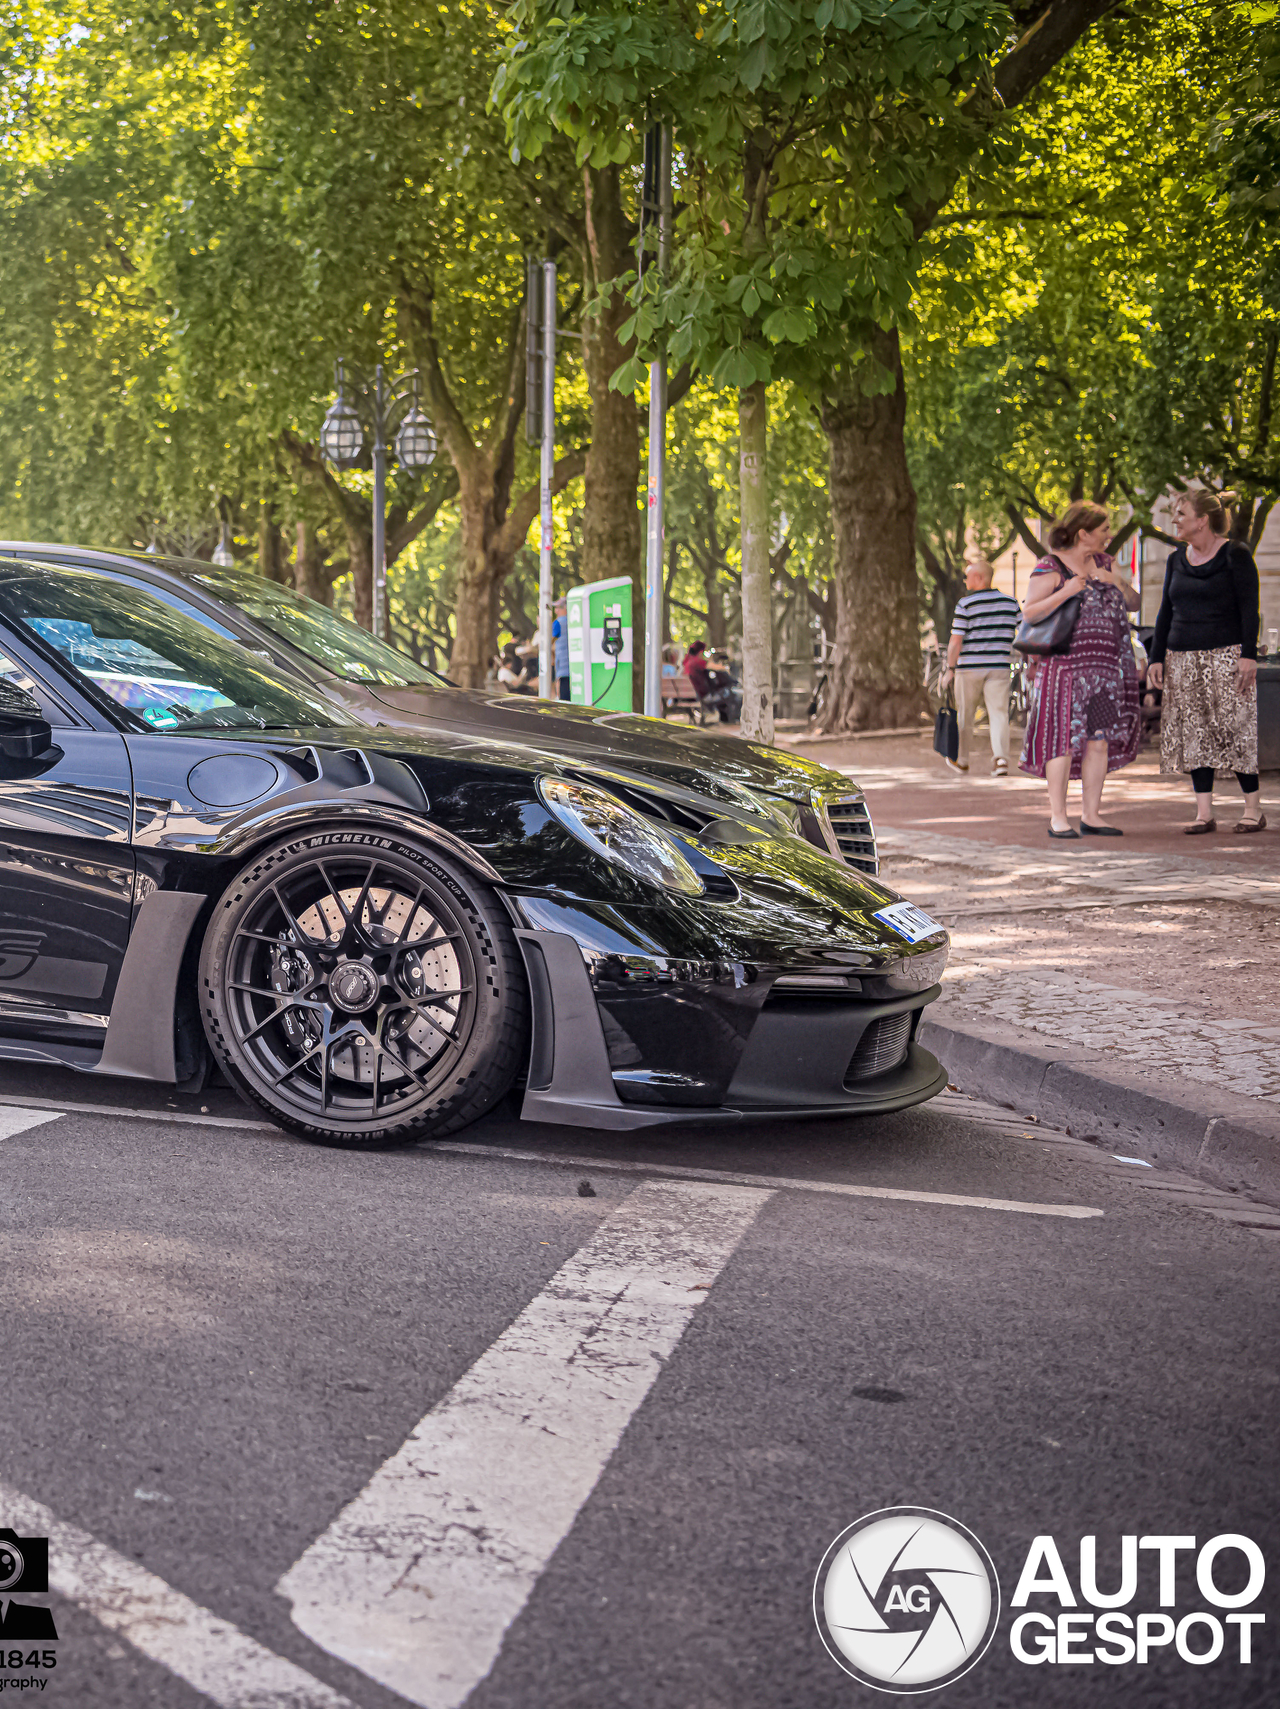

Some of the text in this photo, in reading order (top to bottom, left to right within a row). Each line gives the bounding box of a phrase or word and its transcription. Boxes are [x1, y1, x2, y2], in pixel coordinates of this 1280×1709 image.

[310, 834, 393, 849] MICHELIN
[397, 846, 423, 861] PILOT
[421, 859, 448, 881] SPORT
[447, 880, 462, 896] CUP
